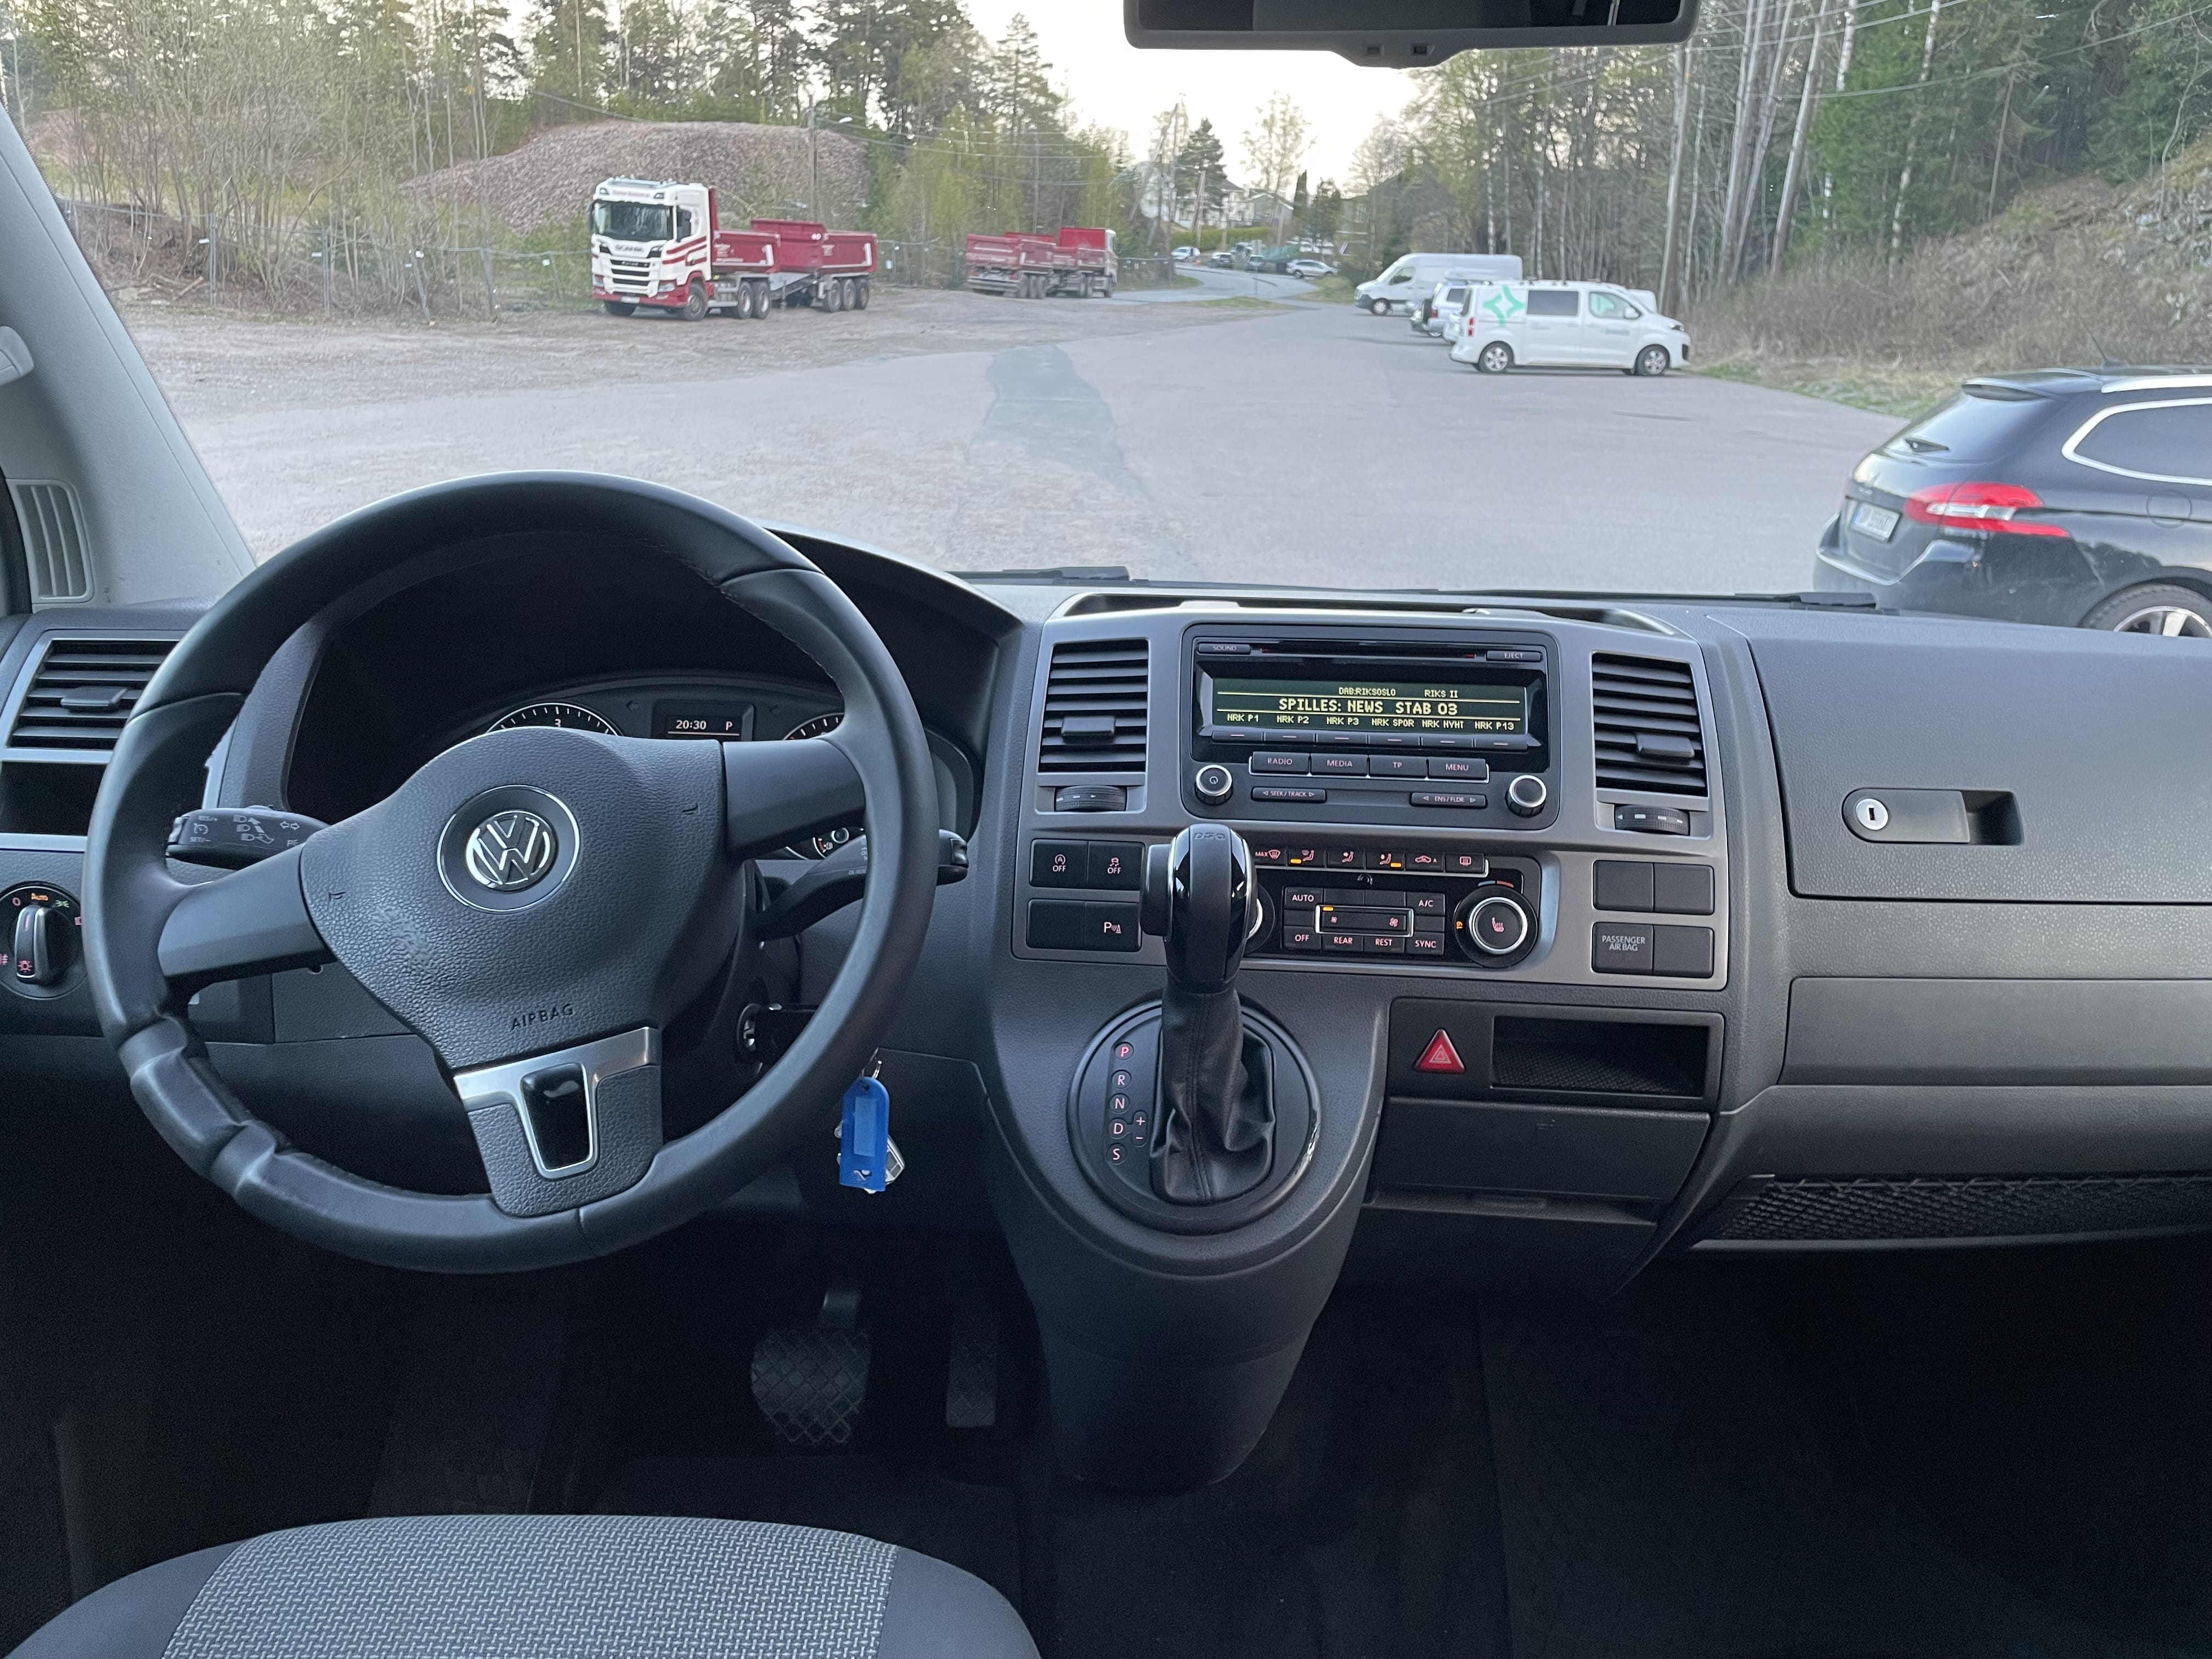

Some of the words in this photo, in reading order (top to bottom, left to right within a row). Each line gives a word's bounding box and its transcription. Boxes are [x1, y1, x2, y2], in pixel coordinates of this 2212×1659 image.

[1424, 690, 1446, 698] RIKS
[1450, 690, 1458, 698] II
[1279, 698, 1341, 712] SPILLES:
[1347, 700, 1383, 713] NEWS
[1396, 701, 1431, 715] STAB
[1227, 713, 1244, 722] NRK
[1248, 714, 1259, 723] P1
[1277, 715, 1294, 724] NRK
[1297, 715, 1310, 724] P2
[1327, 716, 1344, 725] NRK
[1347, 717, 1359, 725] P3
[1372, 718, 1389, 727] NRK
[1392, 719, 1414, 727] SPOR
[555, 719, 561, 727] 3
[675, 720, 707, 730] 20:30
[726, 721, 733, 731] P
[1422, 719, 1440, 728] NRK
[1475, 721, 1493, 730] NRK
[1496, 721, 1514, 730] P13
[1415, 940, 1436, 948] SYNC
[1602, 935, 1645, 944] PASSENGER
[511, 1003, 573, 1030] AIRBAG
[1120, 1047, 1129, 1057] P
[1118, 1075, 1125, 1085] R
[1115, 1098, 1125, 1109] N
[1113, 1122, 1124, 1135] D
[1113, 1148, 1120, 1160] S
